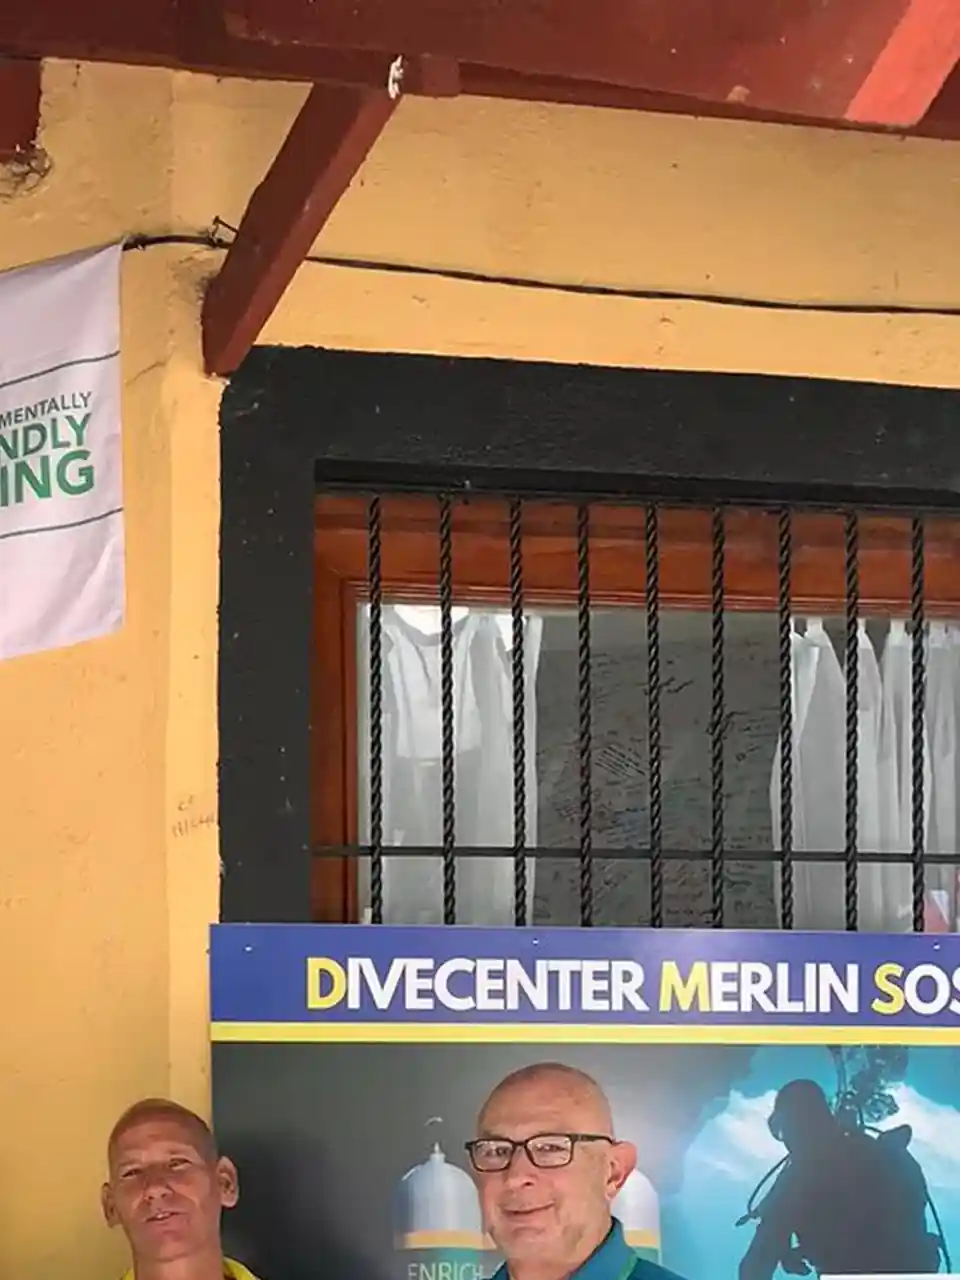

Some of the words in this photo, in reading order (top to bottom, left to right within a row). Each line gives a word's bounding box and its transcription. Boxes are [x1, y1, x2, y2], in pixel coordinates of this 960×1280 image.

[306, 957, 649, 1012] DIVECENTER
[659, 960, 859, 1014] MERLIN
[872, 962, 960, 1015] SO
